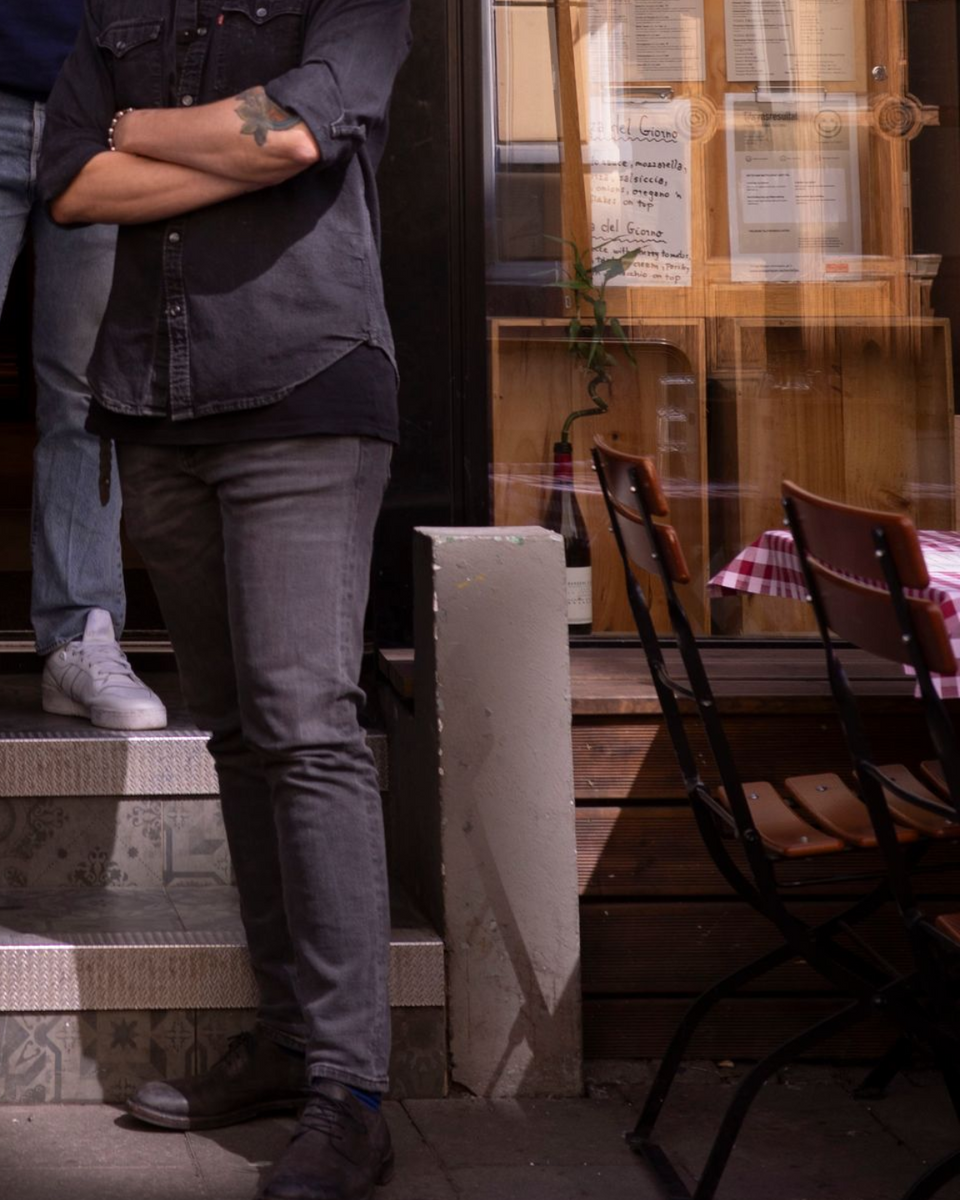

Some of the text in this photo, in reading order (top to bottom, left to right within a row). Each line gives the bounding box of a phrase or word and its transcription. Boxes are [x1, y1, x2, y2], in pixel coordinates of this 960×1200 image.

[639, 114, 678, 139] Giorno
[635, 159, 687, 174] mozzarella,
[619, 173, 668, 187] salsiccia,
[632, 189, 670, 202] oregano
[637, 199, 654, 212] top
[601, 219, 619, 233] del
[627, 221, 664, 238] Giorno
[665, 271, 681, 284] top
